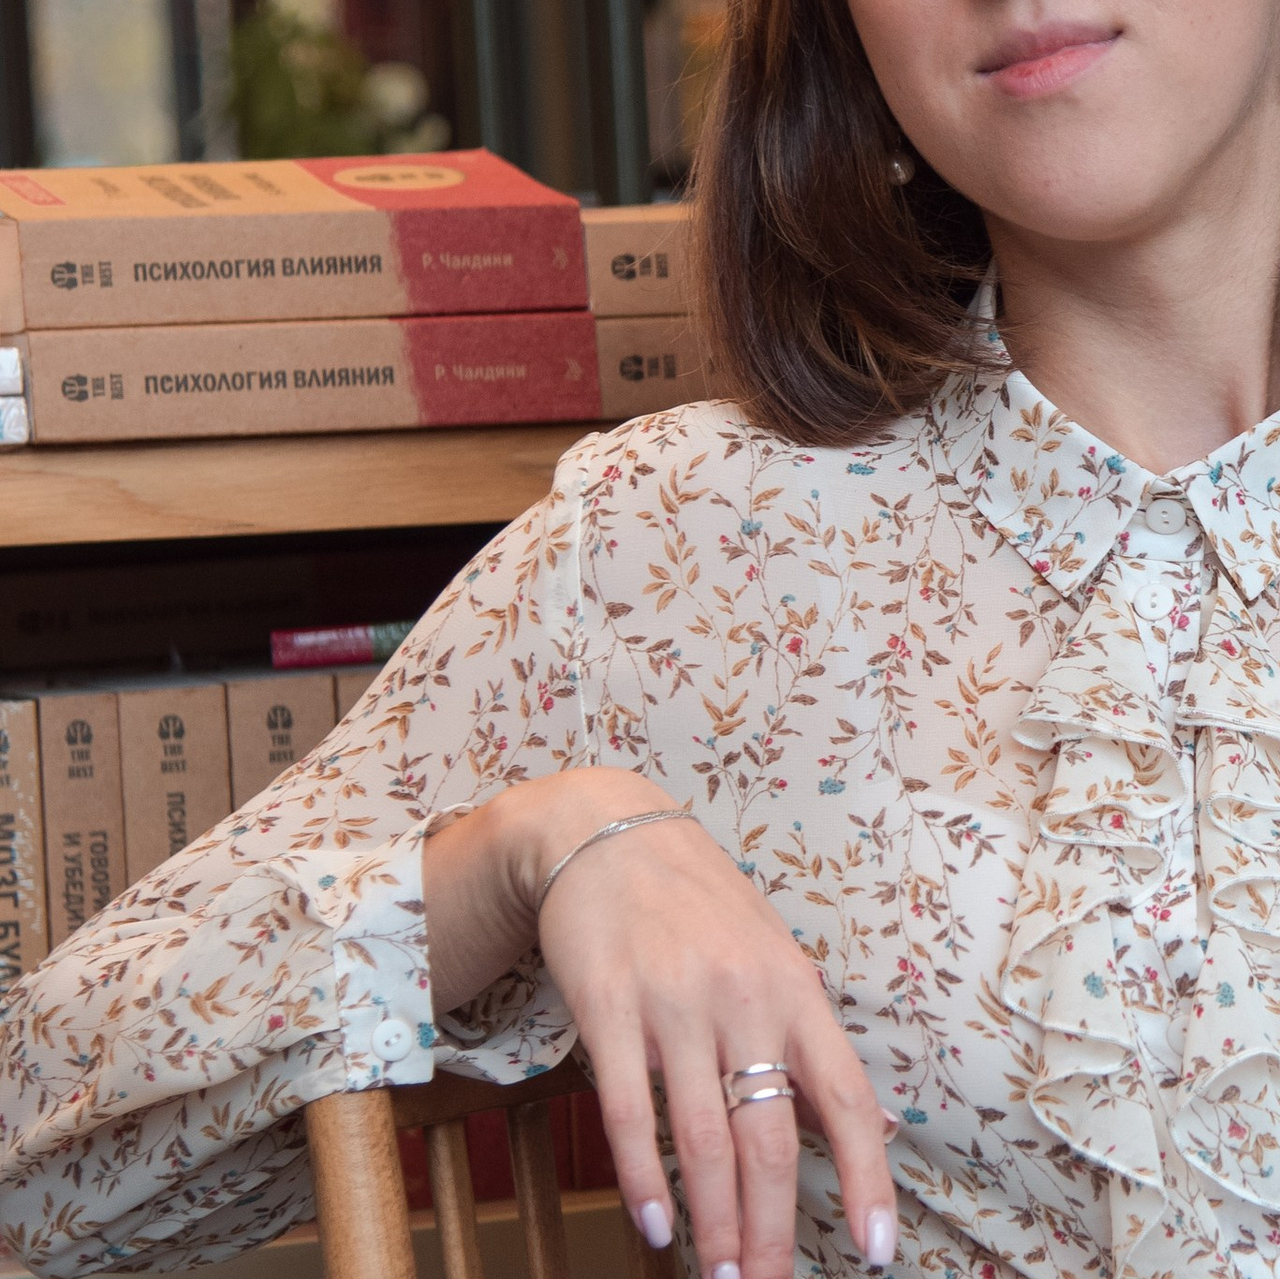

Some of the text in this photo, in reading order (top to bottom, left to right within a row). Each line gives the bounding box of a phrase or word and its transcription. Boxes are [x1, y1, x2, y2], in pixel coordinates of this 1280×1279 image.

[132, 253, 383, 283] ПСИХОЛОГИЯ ВЛИЯНИЯ
[440, 252, 514, 271] Чалдини
[144, 364, 396, 396] ПСИХОЛОГИЯ ВЛИЯНИЯ
[452, 363, 527, 383] Чалдини
